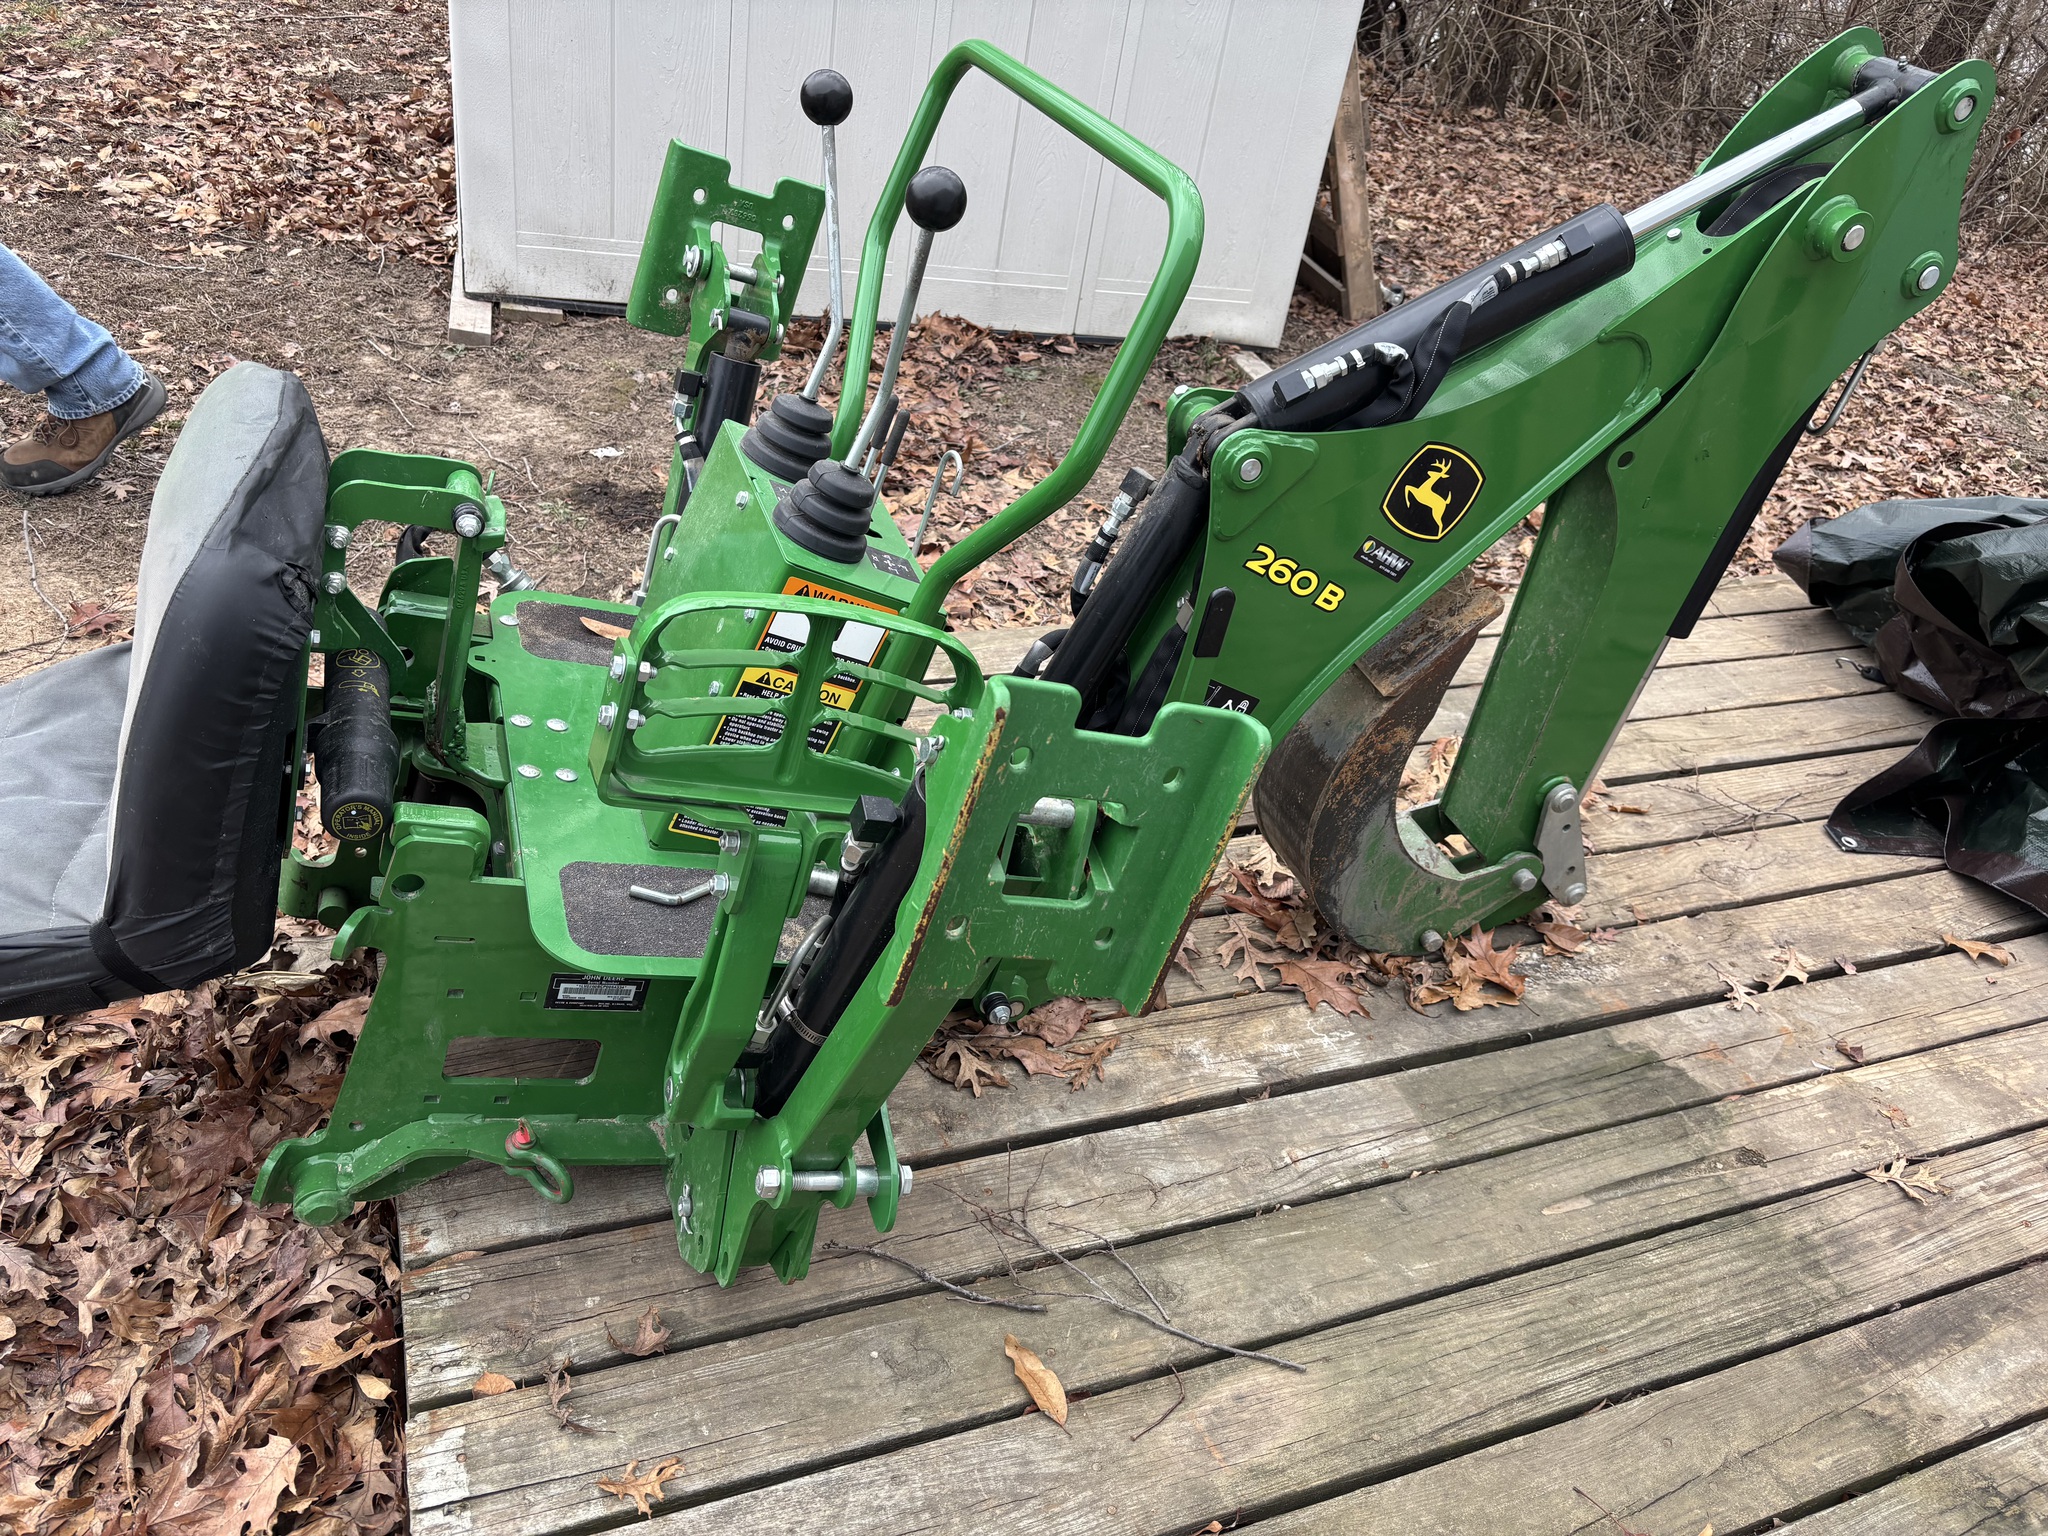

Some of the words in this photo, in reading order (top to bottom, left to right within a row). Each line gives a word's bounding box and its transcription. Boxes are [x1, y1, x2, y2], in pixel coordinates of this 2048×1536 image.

[1370, 546, 1408, 571] AHW
[1243, 543, 1320, 597] 260
[1312, 580, 1346, 613] B
[764, 636, 786, 648] AVOID
[761, 689, 780, 698] HELP
[729, 722, 751, 731] operators.
[746, 721, 764, 729] operate
[763, 725, 779, 733] tractor
[724, 731, 740, 739] device
[738, 729, 757, 737] backhoe
[756, 734, 770, 742] swing
[334, 804, 363, 830] OPERATOR'S
[363, 805, 381, 826] MANUAL
[751, 809, 774, 818] excavation
[773, 813, 787, 821] banks
[679, 823, 699, 831] attached
[346, 831, 371, 840] INSIDE
